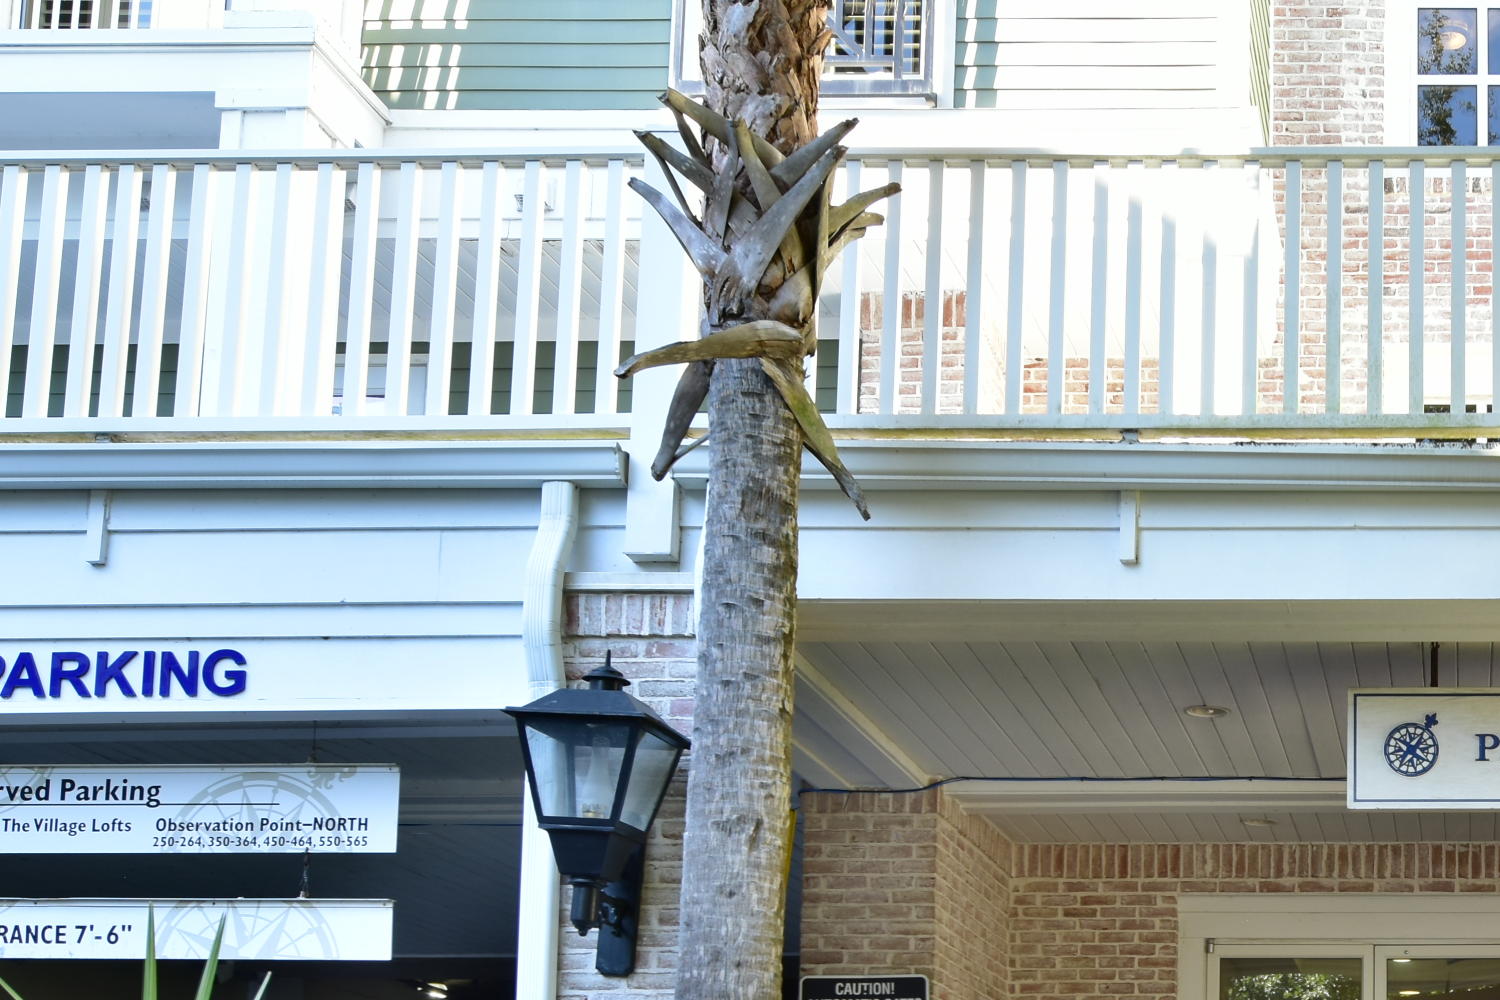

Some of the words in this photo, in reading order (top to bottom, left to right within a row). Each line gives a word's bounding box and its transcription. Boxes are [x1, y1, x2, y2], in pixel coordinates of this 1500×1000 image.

[0, 649, 247, 698] ARKING
[60, 778, 162, 808] Parking
[2, 818, 31, 832] The
[34, 818, 87, 836] Village
[92, 818, 132, 832] Lofts
[155, 817, 254, 832] Observation
[835, 982, 895, 996] CAUTION!
